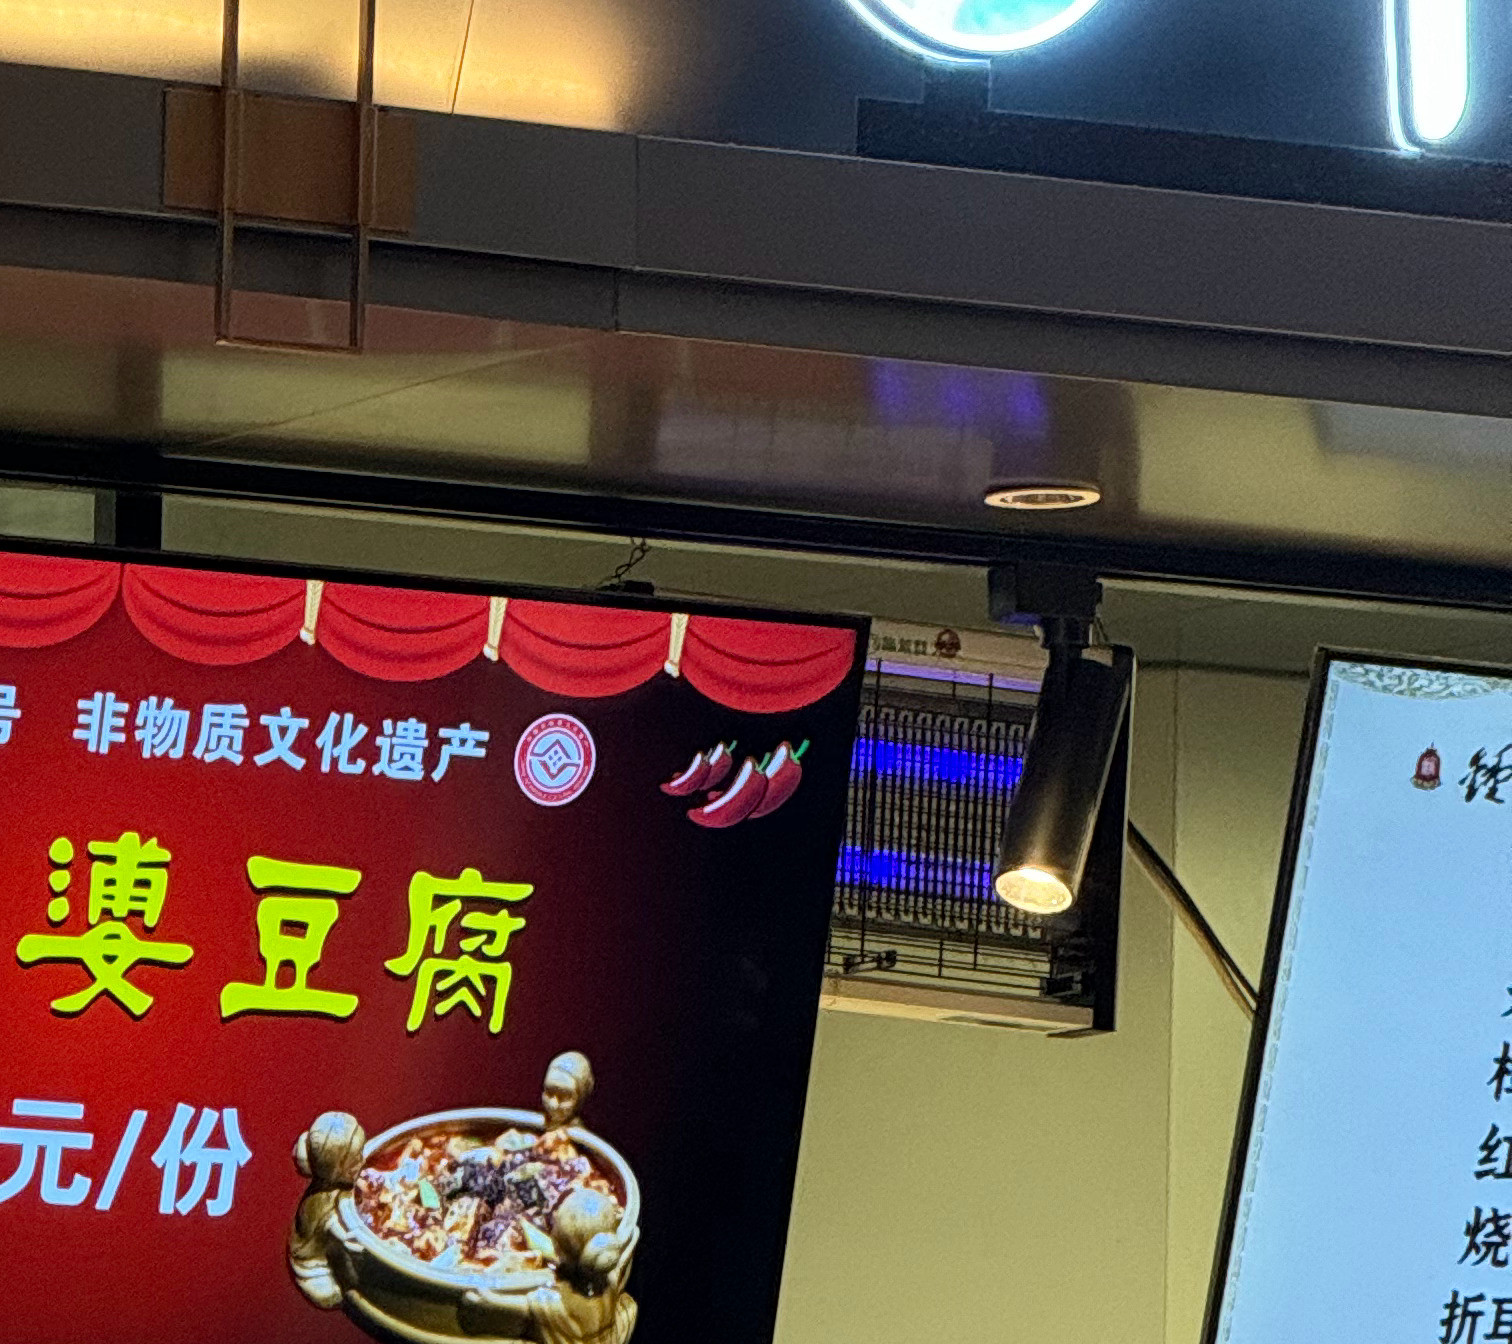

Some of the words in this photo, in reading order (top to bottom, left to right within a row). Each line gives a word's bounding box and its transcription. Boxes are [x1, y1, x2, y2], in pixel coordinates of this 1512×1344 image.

[73, 691, 490, 783] 非物质文化遗产
